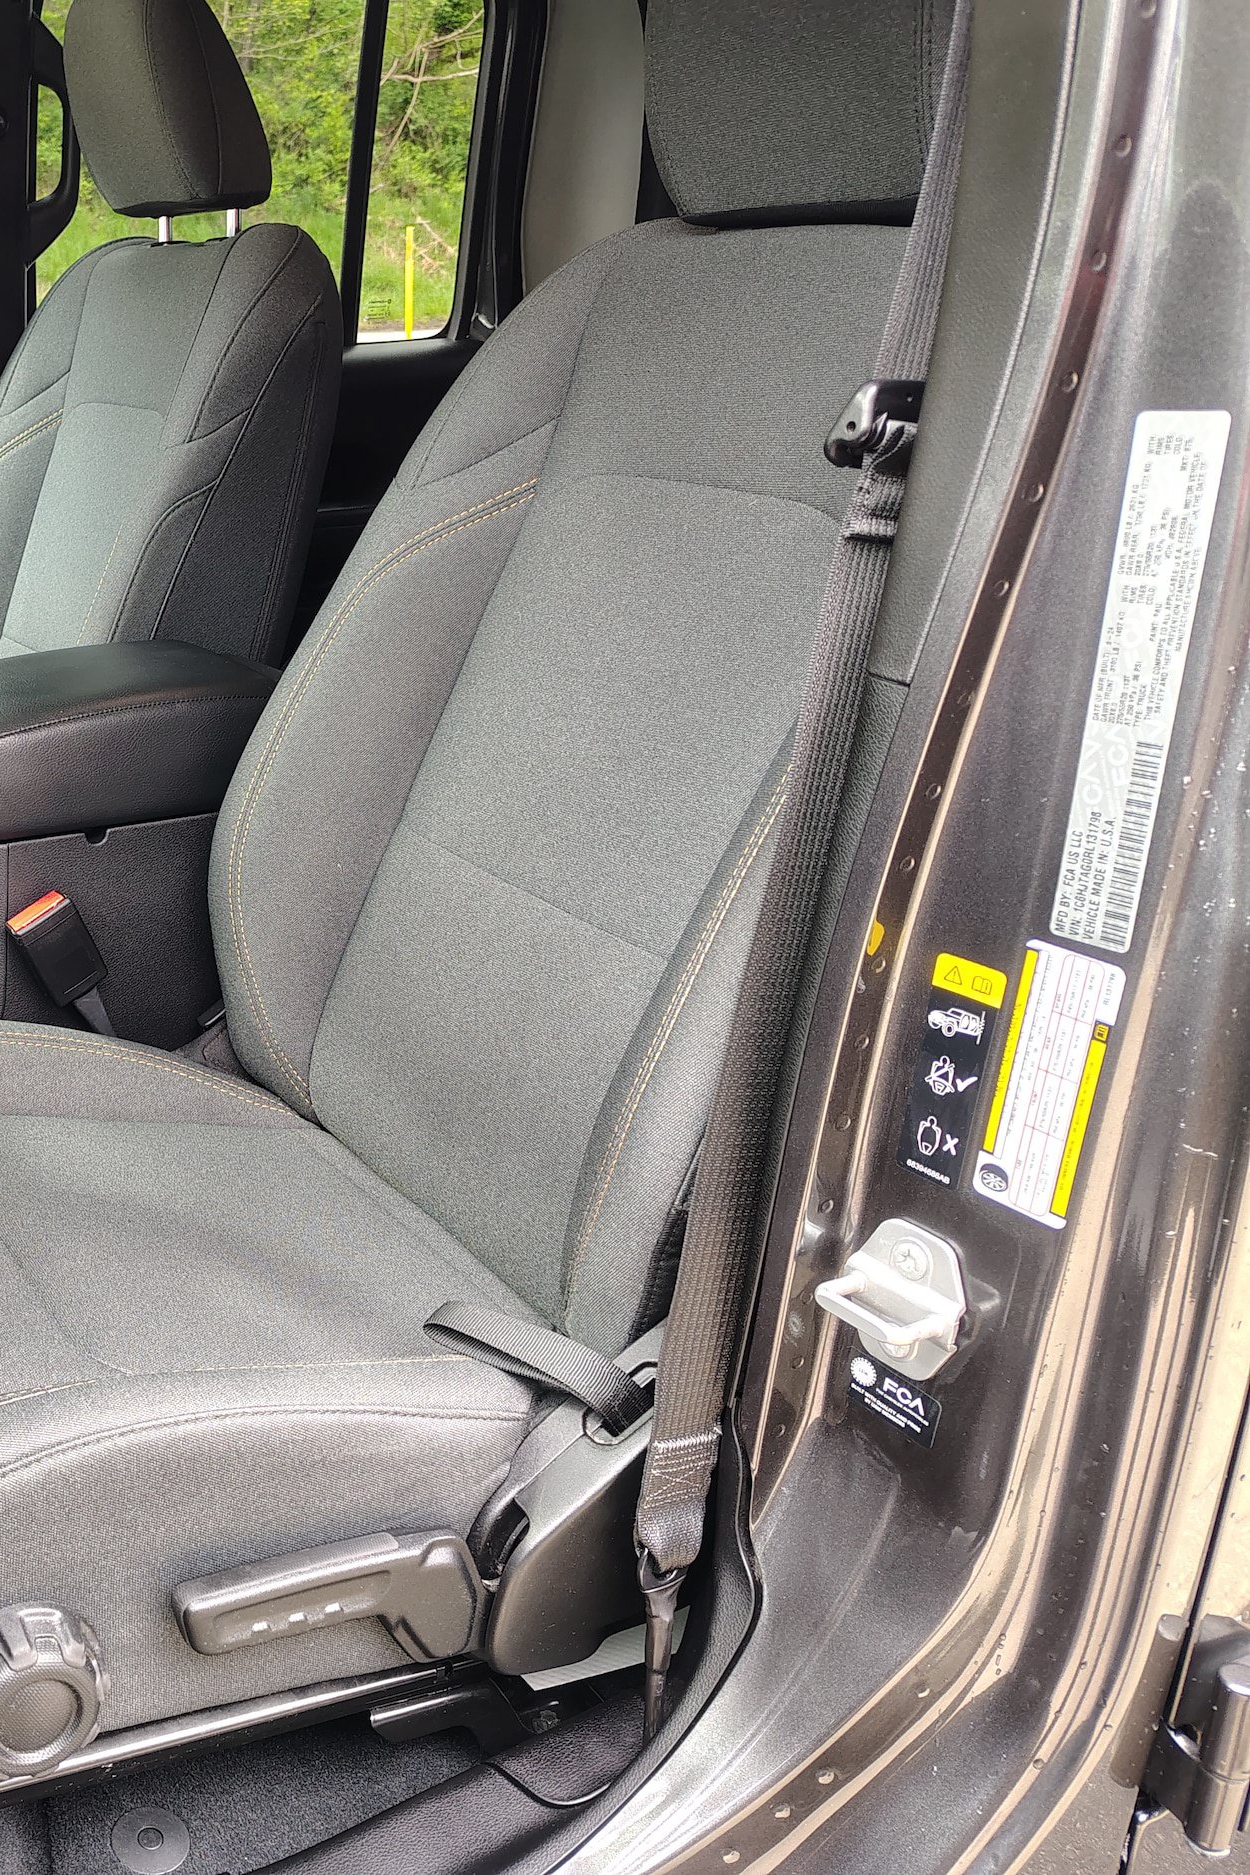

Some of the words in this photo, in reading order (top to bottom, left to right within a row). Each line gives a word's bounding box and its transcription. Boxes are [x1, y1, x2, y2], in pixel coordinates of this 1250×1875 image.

[1069, 829, 1083, 848] LLC
[1066, 849, 1079, 865] US
[1096, 849, 1109, 865] IN:
[1062, 867, 1076, 887] FCA
[1090, 867, 1107, 897] MADE
[1058, 890, 1072, 908] BY:
[1054, 909, 1069, 933] MFD
[1067, 916, 1083, 937] VIN:
[1081, 899, 1101, 941] VEHICLE
[882, 1378, 924, 1415] FCA
